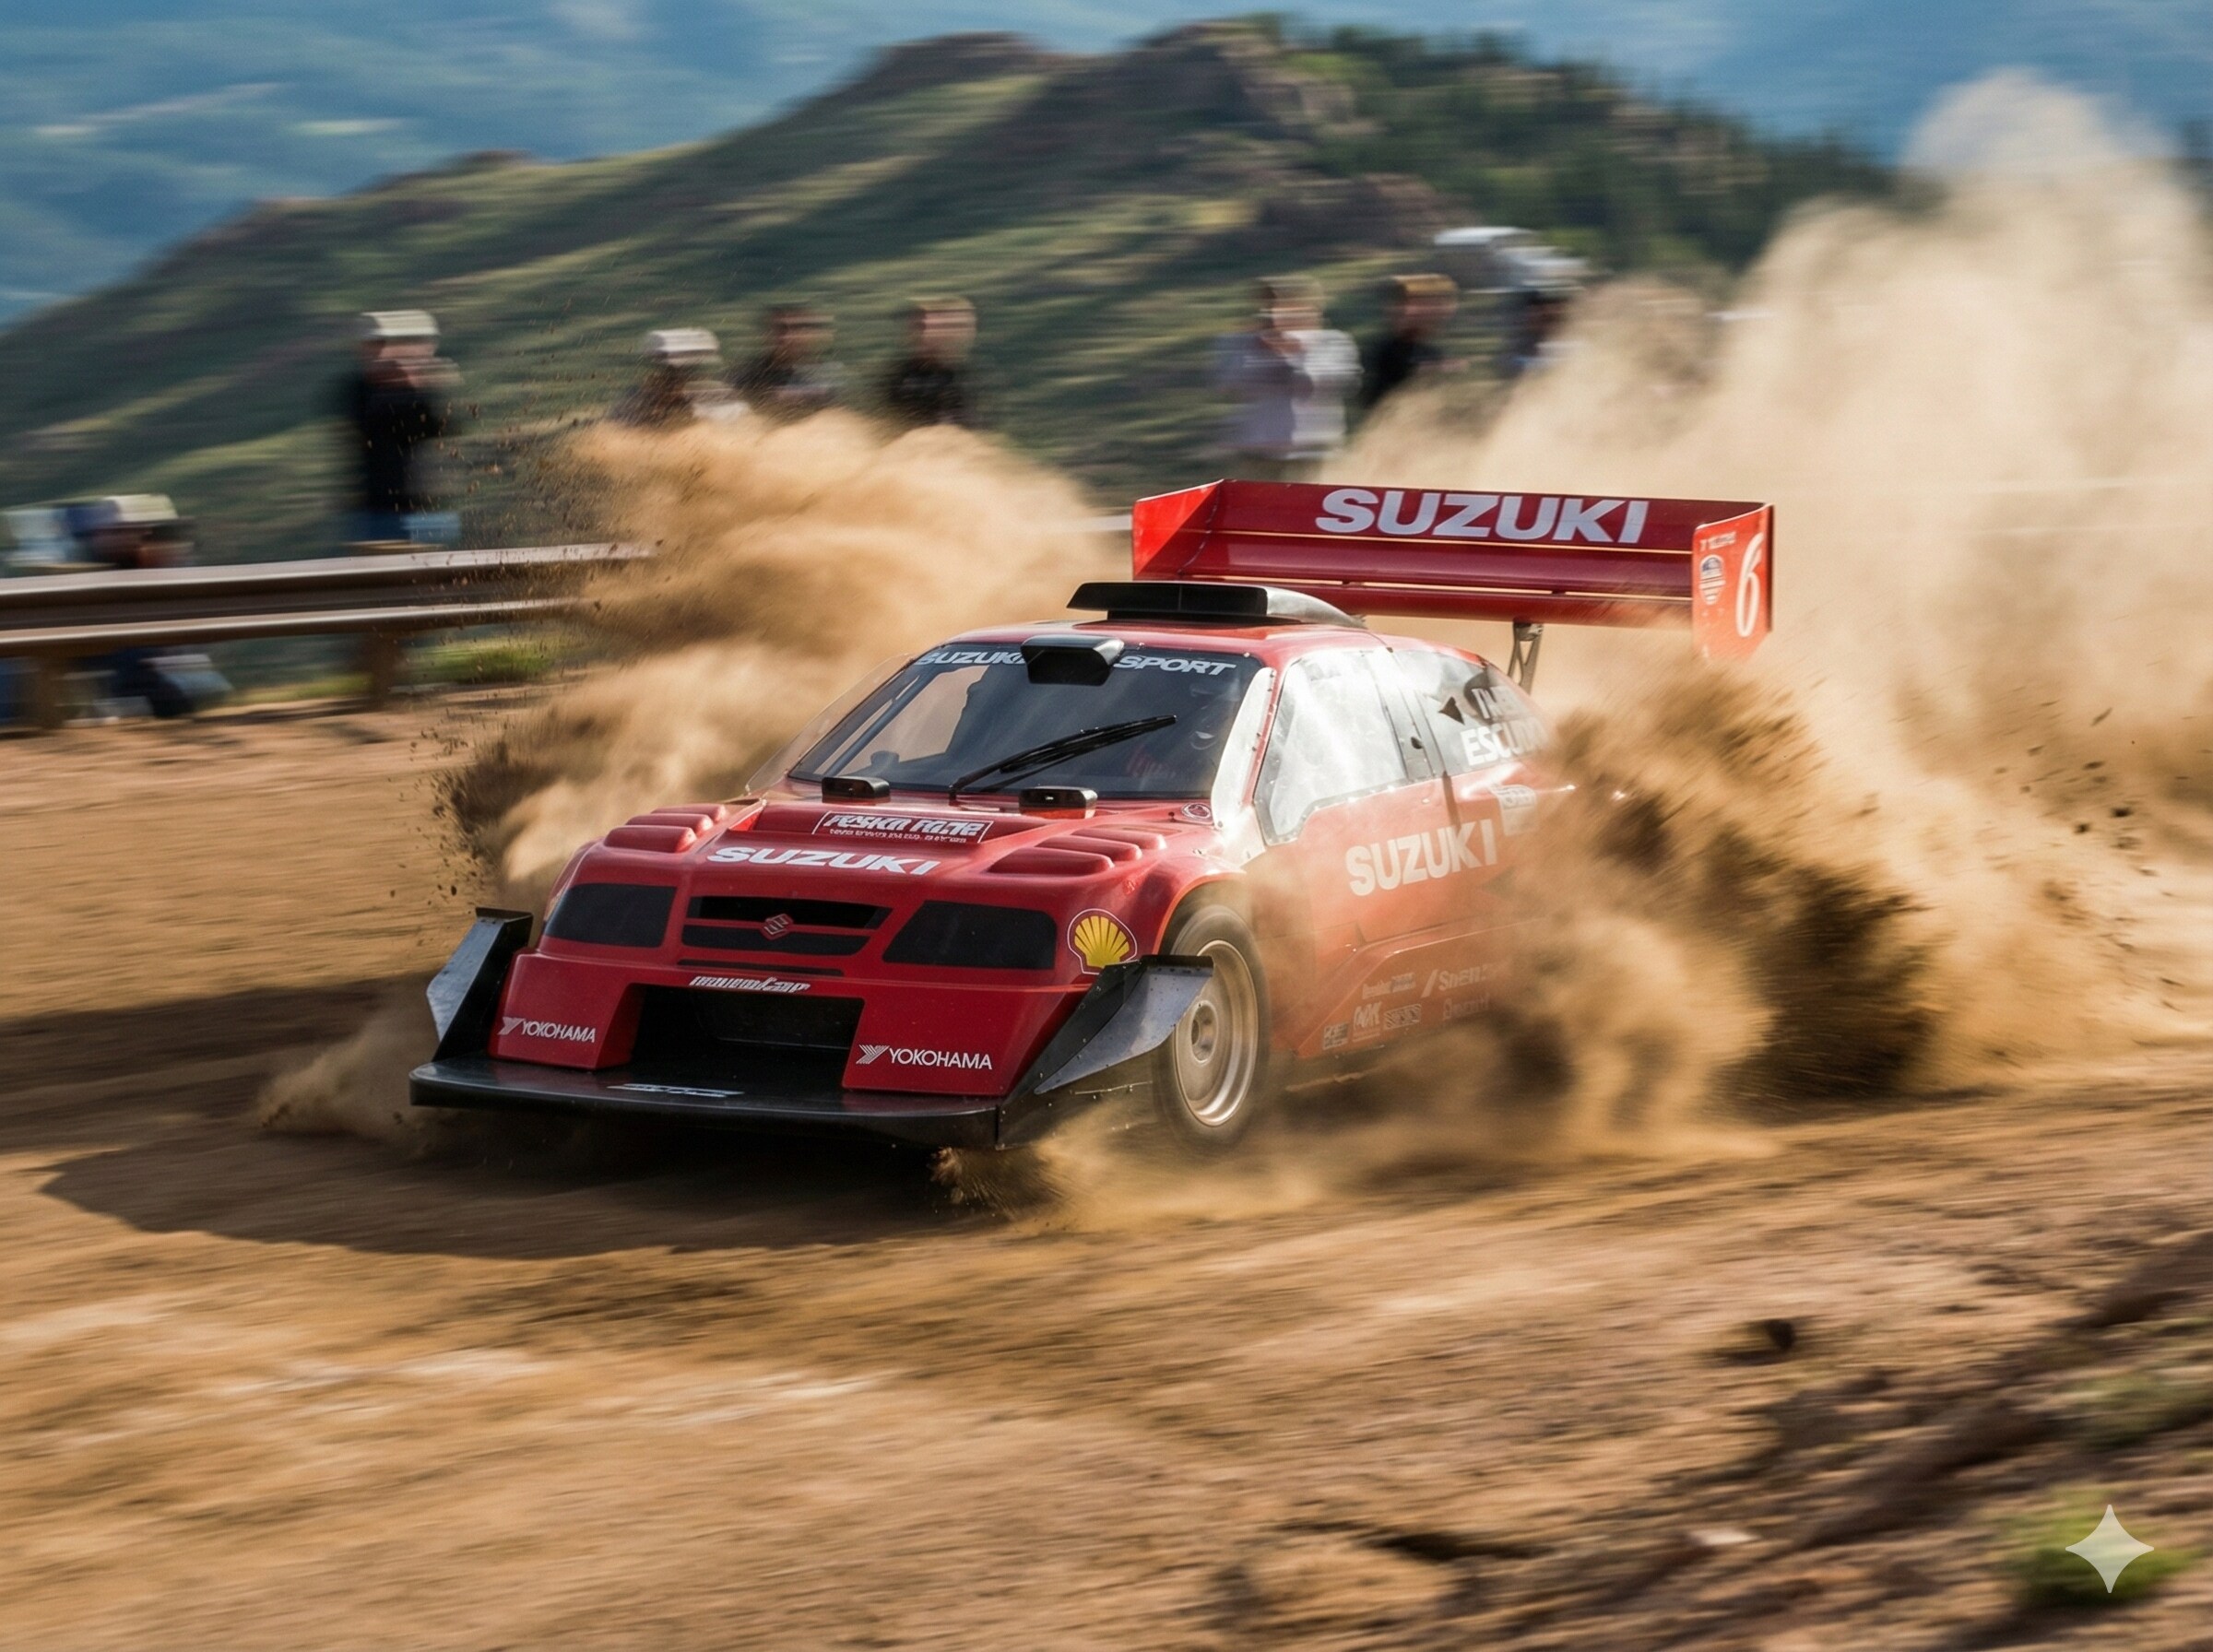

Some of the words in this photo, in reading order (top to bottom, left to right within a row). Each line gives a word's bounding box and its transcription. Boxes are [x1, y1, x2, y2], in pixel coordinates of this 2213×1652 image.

[1316, 489, 1649, 544] SUZUKI
[1735, 531, 1764, 638] 6
[1113, 655, 1237, 676] SPORT
[706, 846, 941, 876] SUZUKI
[1344, 818, 1498, 897] SUZUKI
[521, 1021, 597, 1044] YOKOHAMA
[889, 1047, 993, 1070] YOKOHAMA
